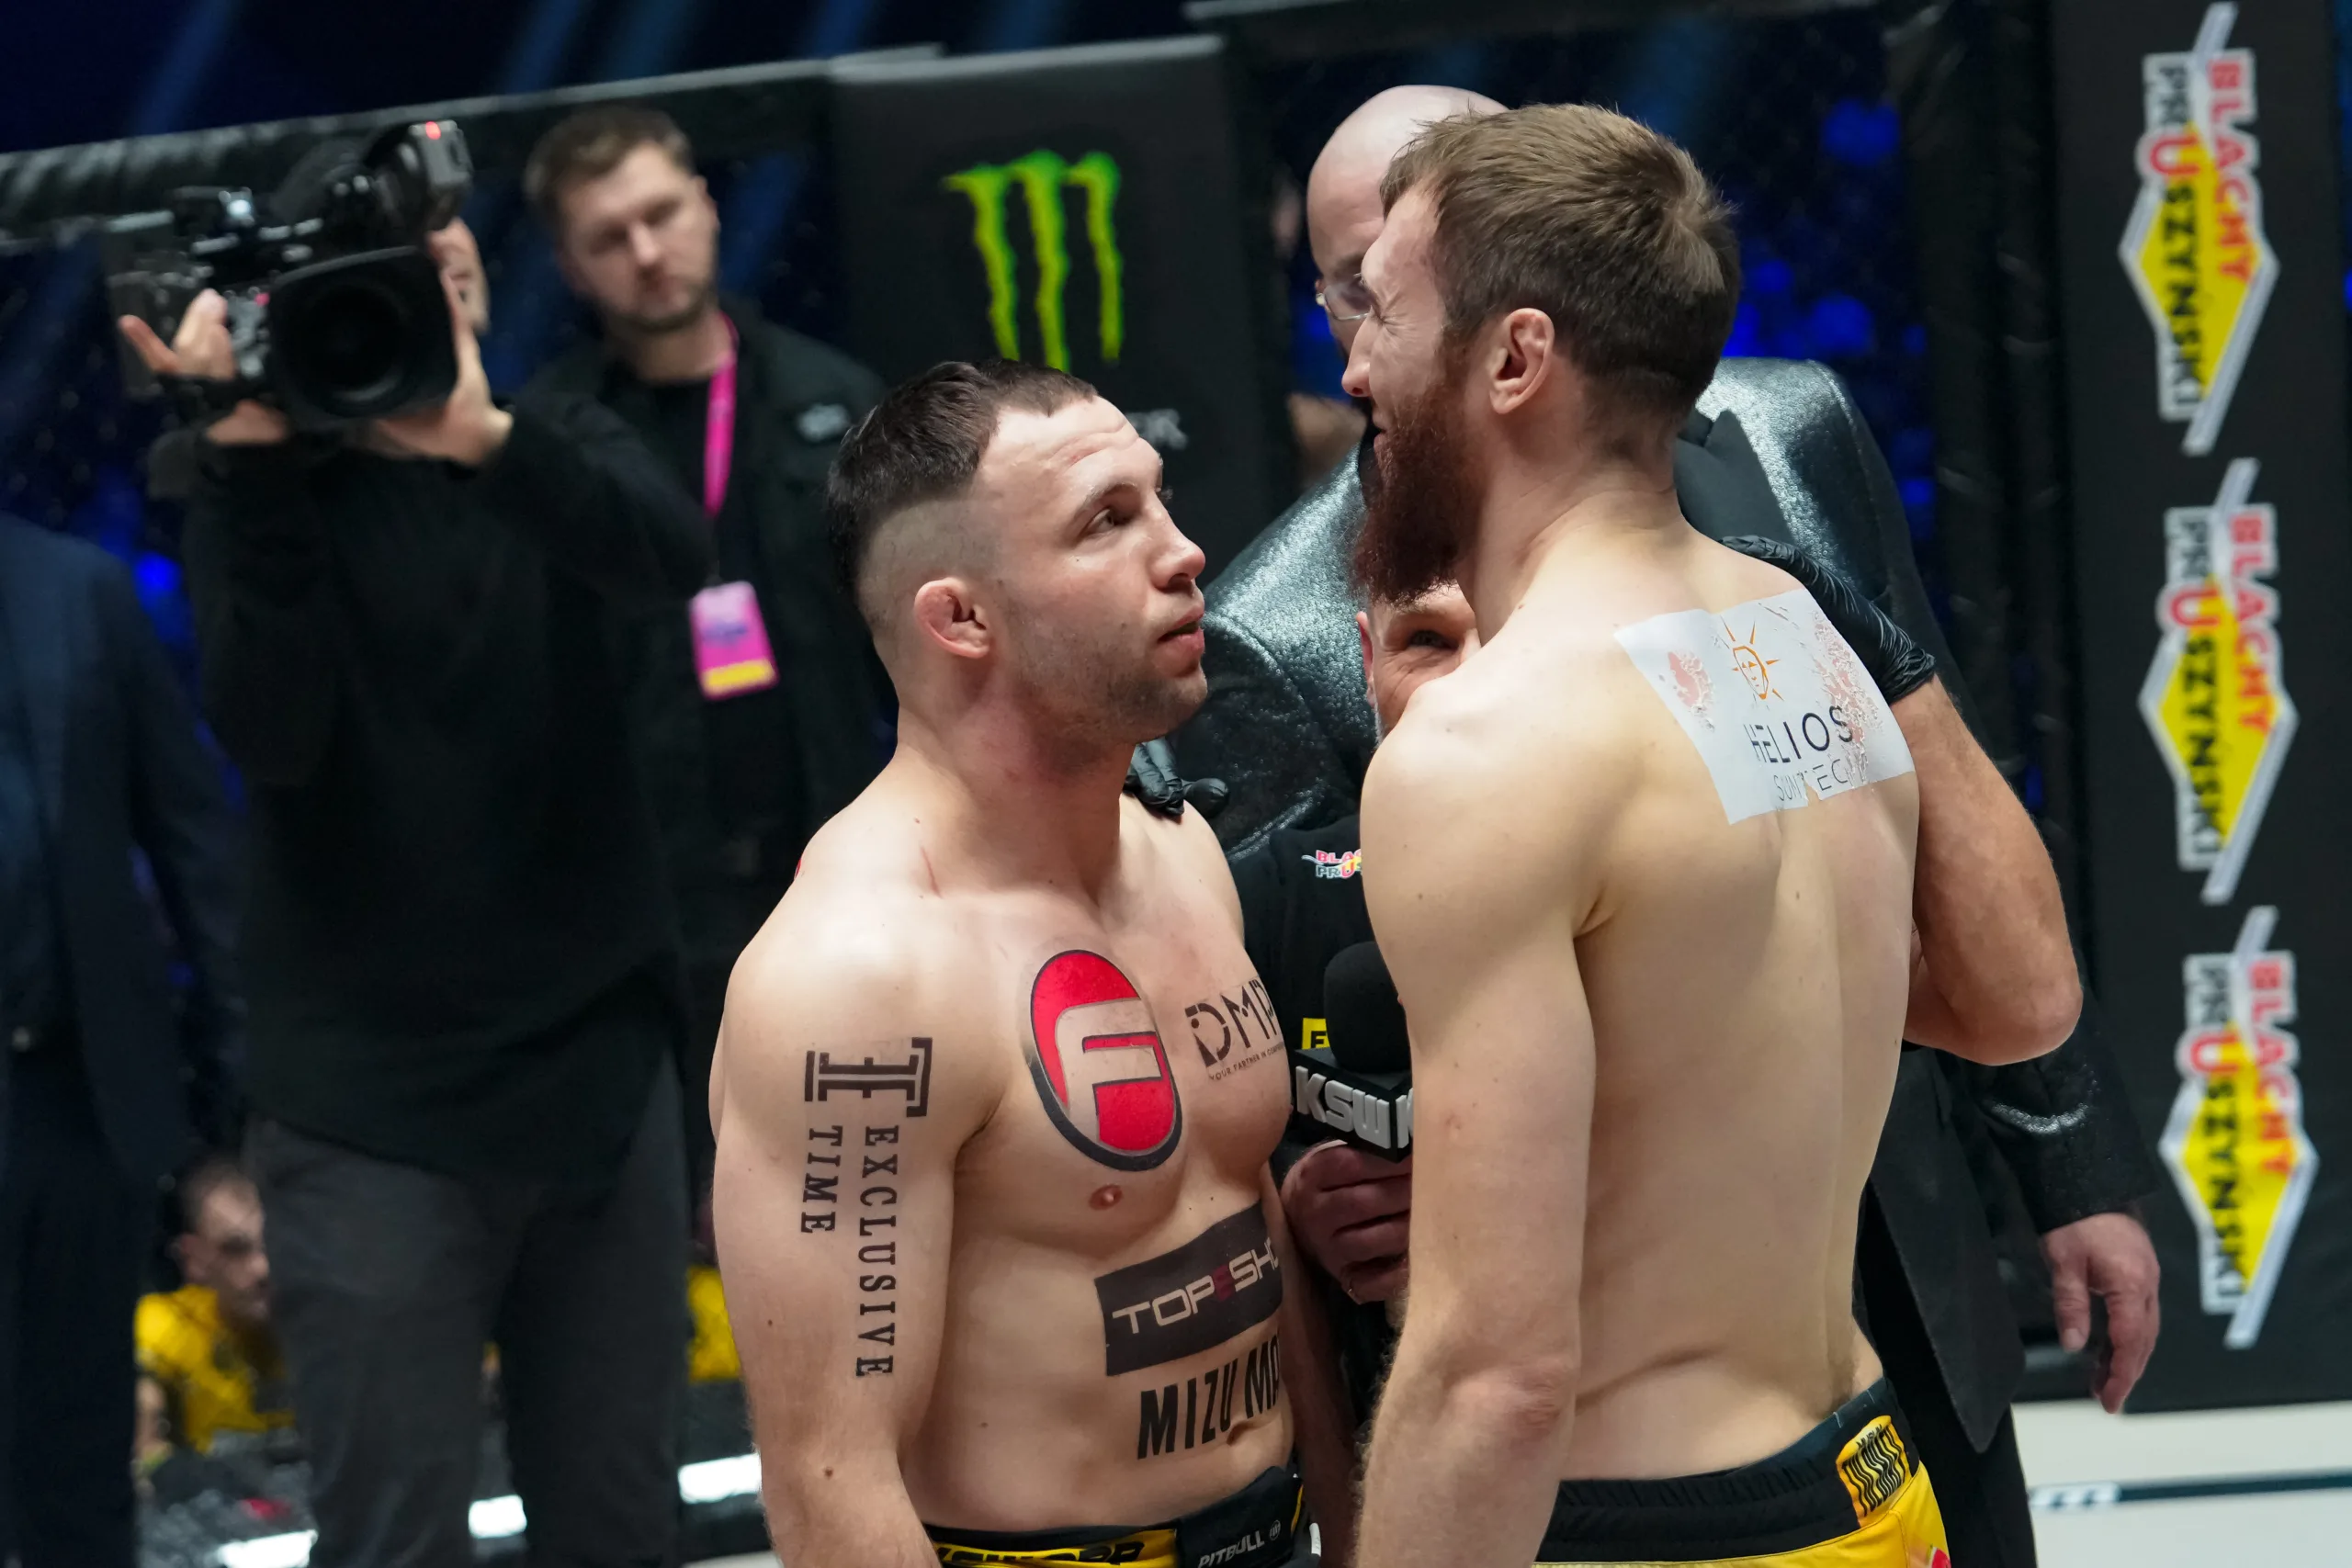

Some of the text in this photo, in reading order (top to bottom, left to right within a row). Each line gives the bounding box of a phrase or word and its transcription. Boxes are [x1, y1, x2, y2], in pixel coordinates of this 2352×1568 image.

[2209, 60, 2254, 284] BLACHY
[2230, 516, 2275, 736] BLACHY
[1743, 705, 1854, 763] HELIOS
[1295, 1066, 1392, 1149] KSW
[2249, 961, 2294, 1177] BLACHY
[800, 1124, 843, 1234] TIME
[855, 1124, 899, 1377] EXCLUSIVE
[1137, 1358, 1238, 1460] MIZU
[1198, 1530, 1265, 1568] PITBULL
